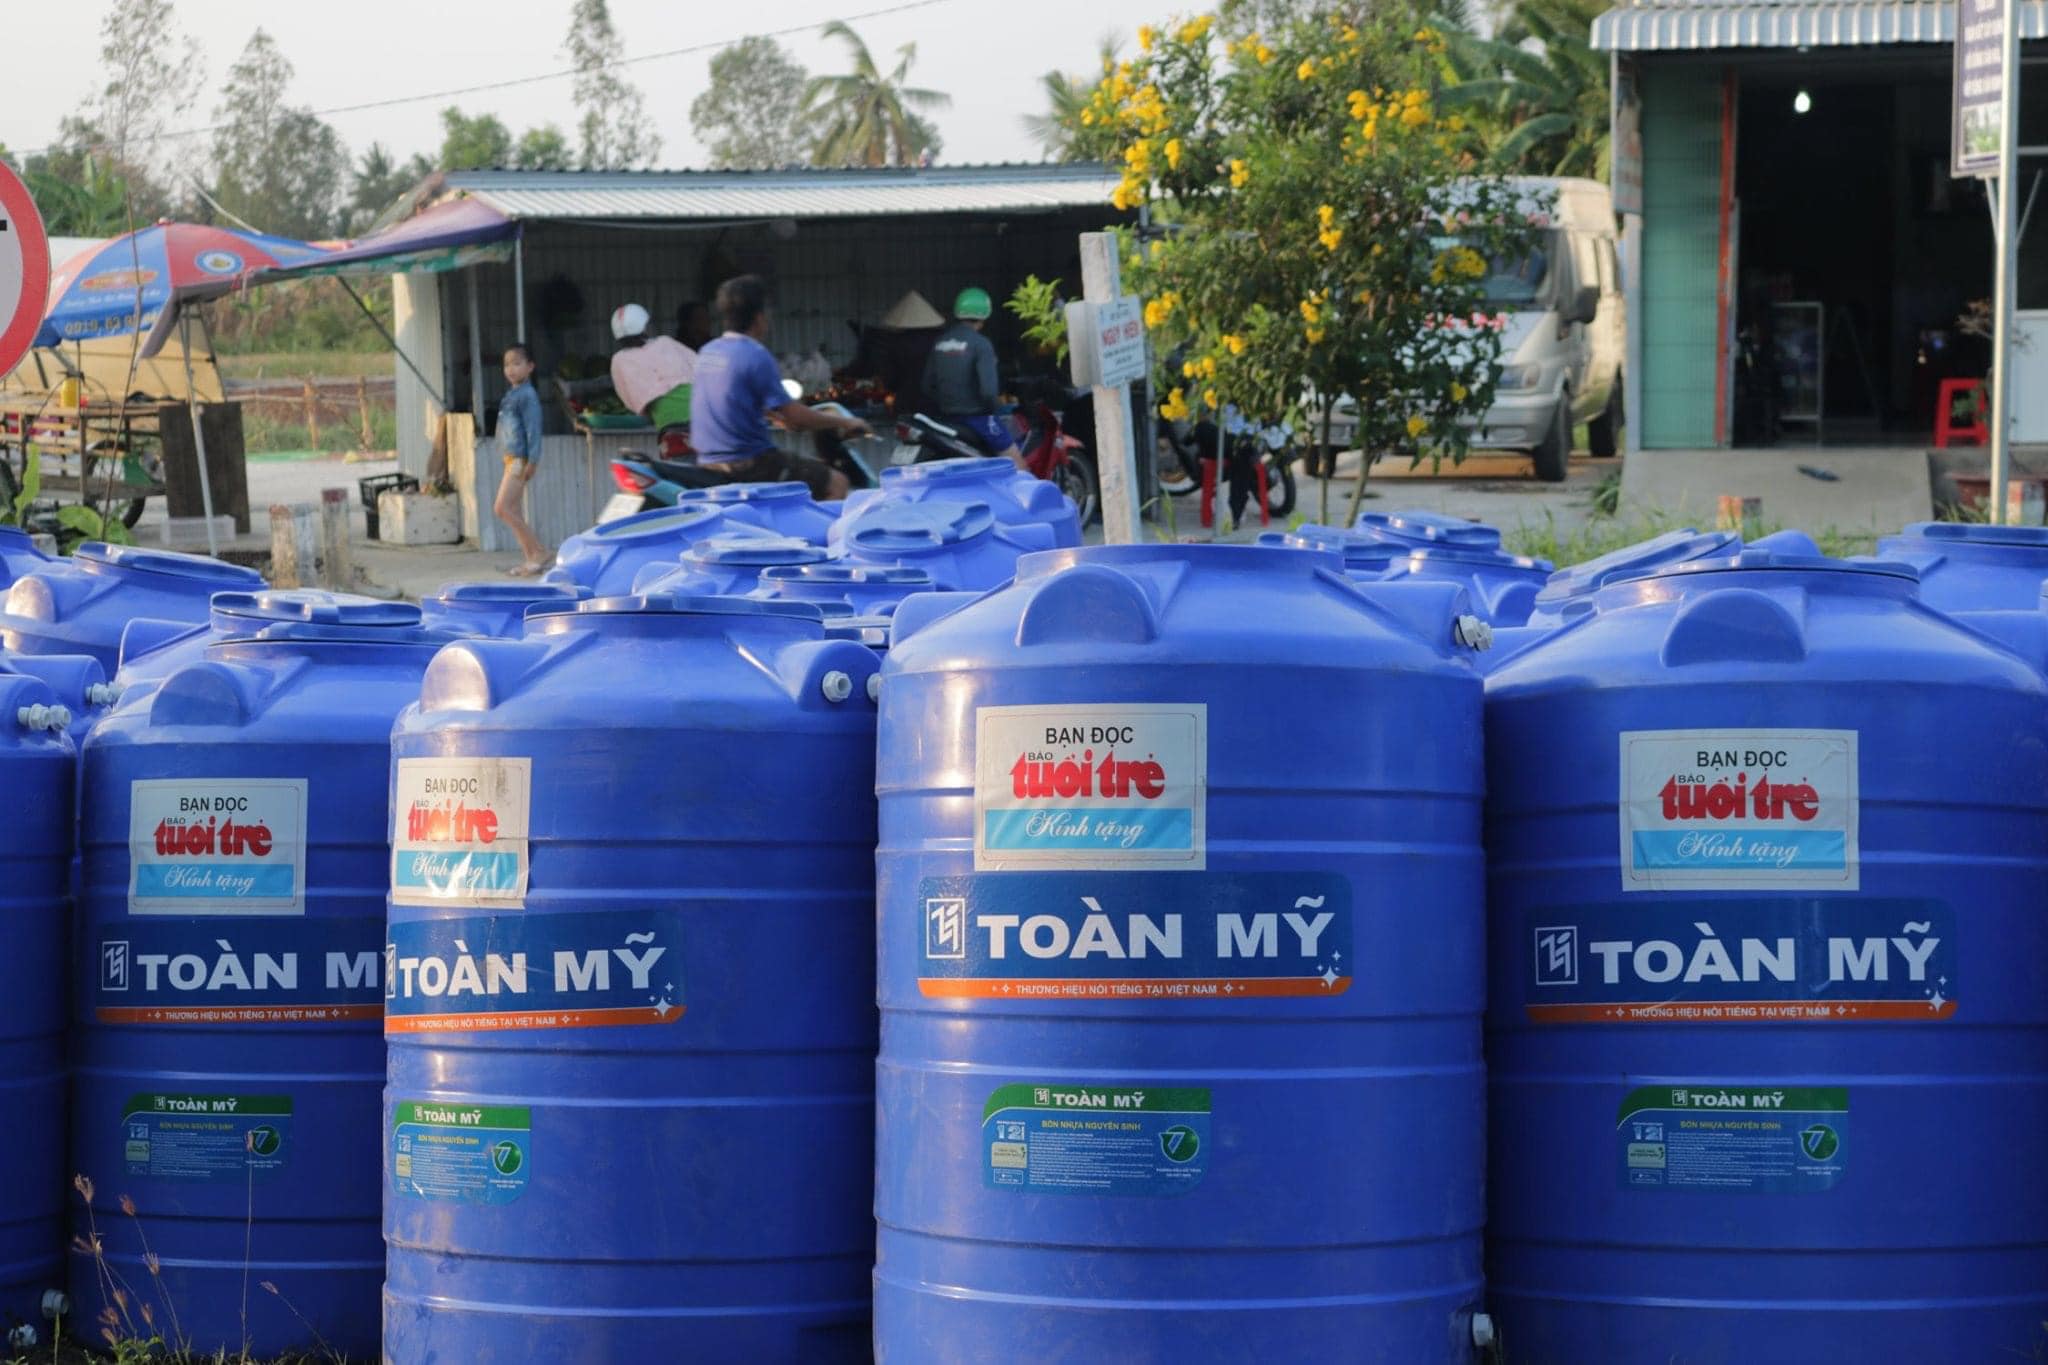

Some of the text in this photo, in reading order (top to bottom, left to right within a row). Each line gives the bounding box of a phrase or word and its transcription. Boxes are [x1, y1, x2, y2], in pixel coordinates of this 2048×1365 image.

[1046, 727, 1134, 748] BẠN ĐỌC
[1697, 751, 1787, 771] BẠN ĐỌC
[1009, 749, 1165, 799] tuổi trẻ
[425, 778, 478, 797] BẠN ĐỌC
[1658, 772, 1819, 821] tuổi trẻ
[180, 797, 248, 815] BẠN ĐỌC
[452, 800, 498, 844] trẻ
[1026, 809, 1145, 848] Kính tặng
[153, 816, 273, 856] tuổi trẻ
[1678, 830, 1801, 868] Kính tặng
[164, 864, 255, 896] Kính tặng
[977, 895, 1335, 959] TOÀN MỸ
[1590, 921, 1940, 985] TOÀN MỸ
[136, 939, 386, 991] TOÀN M
[399, 931, 667, 998] TOÀN MỸ
[1016, 984, 1058, 994] THƯƠNG
[1062, 984, 1085, 996] HIỆU
[1146, 984, 1163, 996] TẠI
[1166, 983, 1189, 996] VIỆT
[1192, 984, 1216, 994] NAM
[305, 1010, 326, 1018] NAM
[536, 1015, 556, 1025] NAM
[1676, 1007, 1700, 1019] HIỆU
[1760, 1007, 1777, 1019] TẠI
[1779, 1006, 1803, 1019] VIỆT
[1806, 1006, 1830, 1016] NAM
[167, 1097, 237, 1112] TOÀN MỸ
[1052, 1089, 1145, 1108] TOÀN MỸ
[1690, 1090, 1785, 1108] TOÀN MỸ
[424, 1107, 482, 1125] TOÀN MỸ
